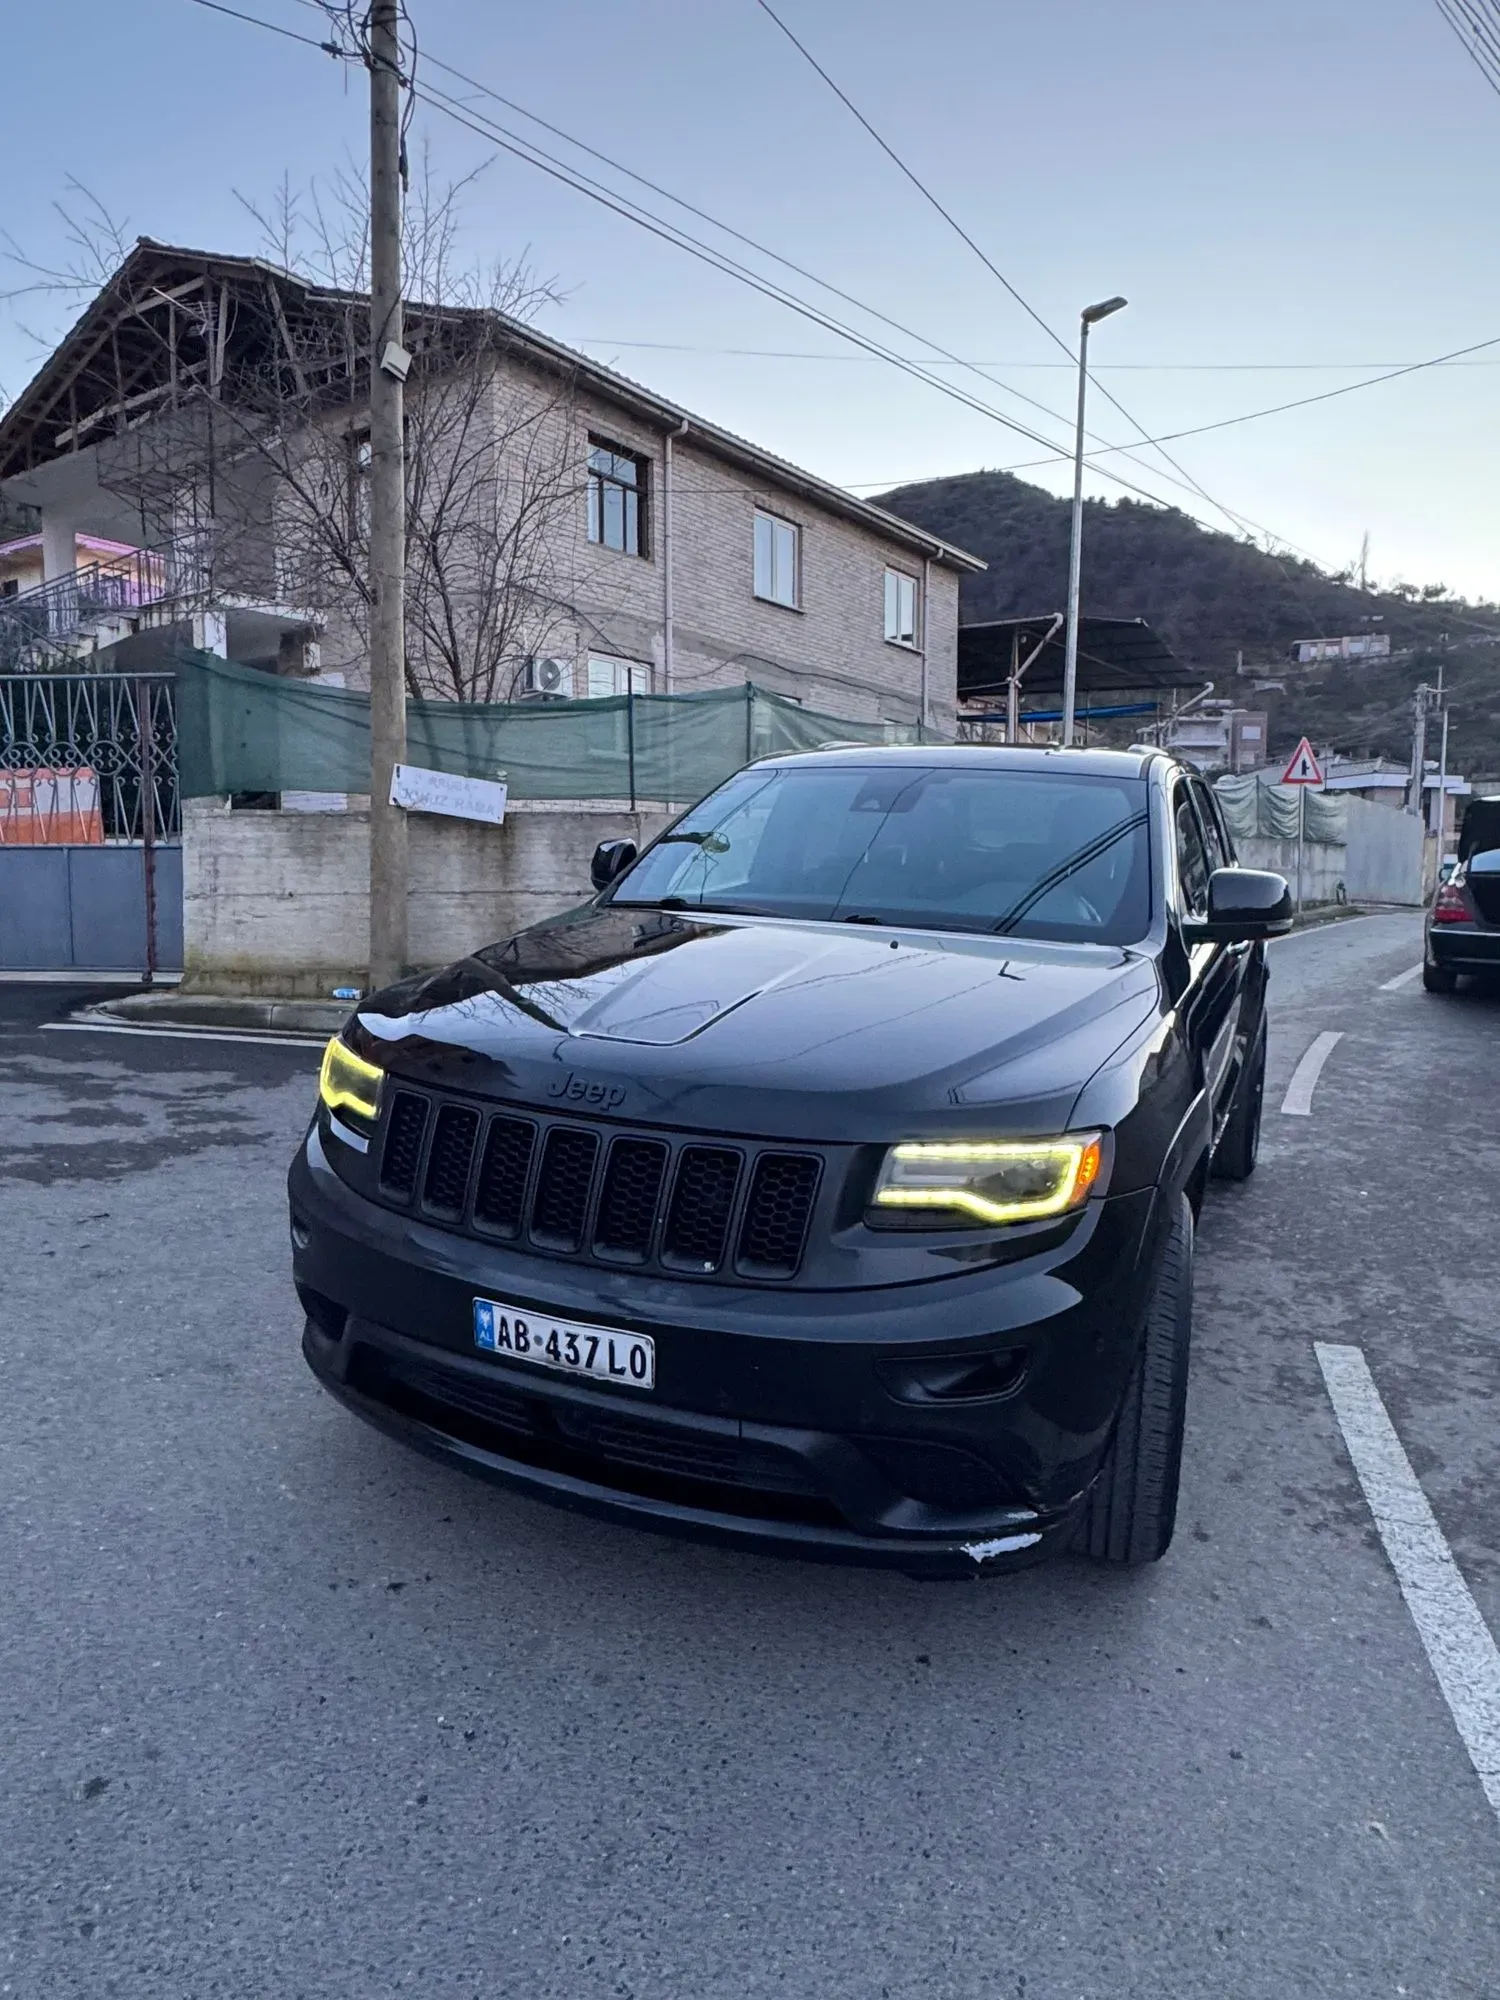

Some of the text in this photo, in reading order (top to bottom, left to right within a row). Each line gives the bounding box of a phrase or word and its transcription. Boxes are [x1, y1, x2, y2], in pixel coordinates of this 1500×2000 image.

[547, 1071, 627, 1111] Jeep
[497, 1314, 531, 1353] AB
[545, 1329, 601, 1369] 437
